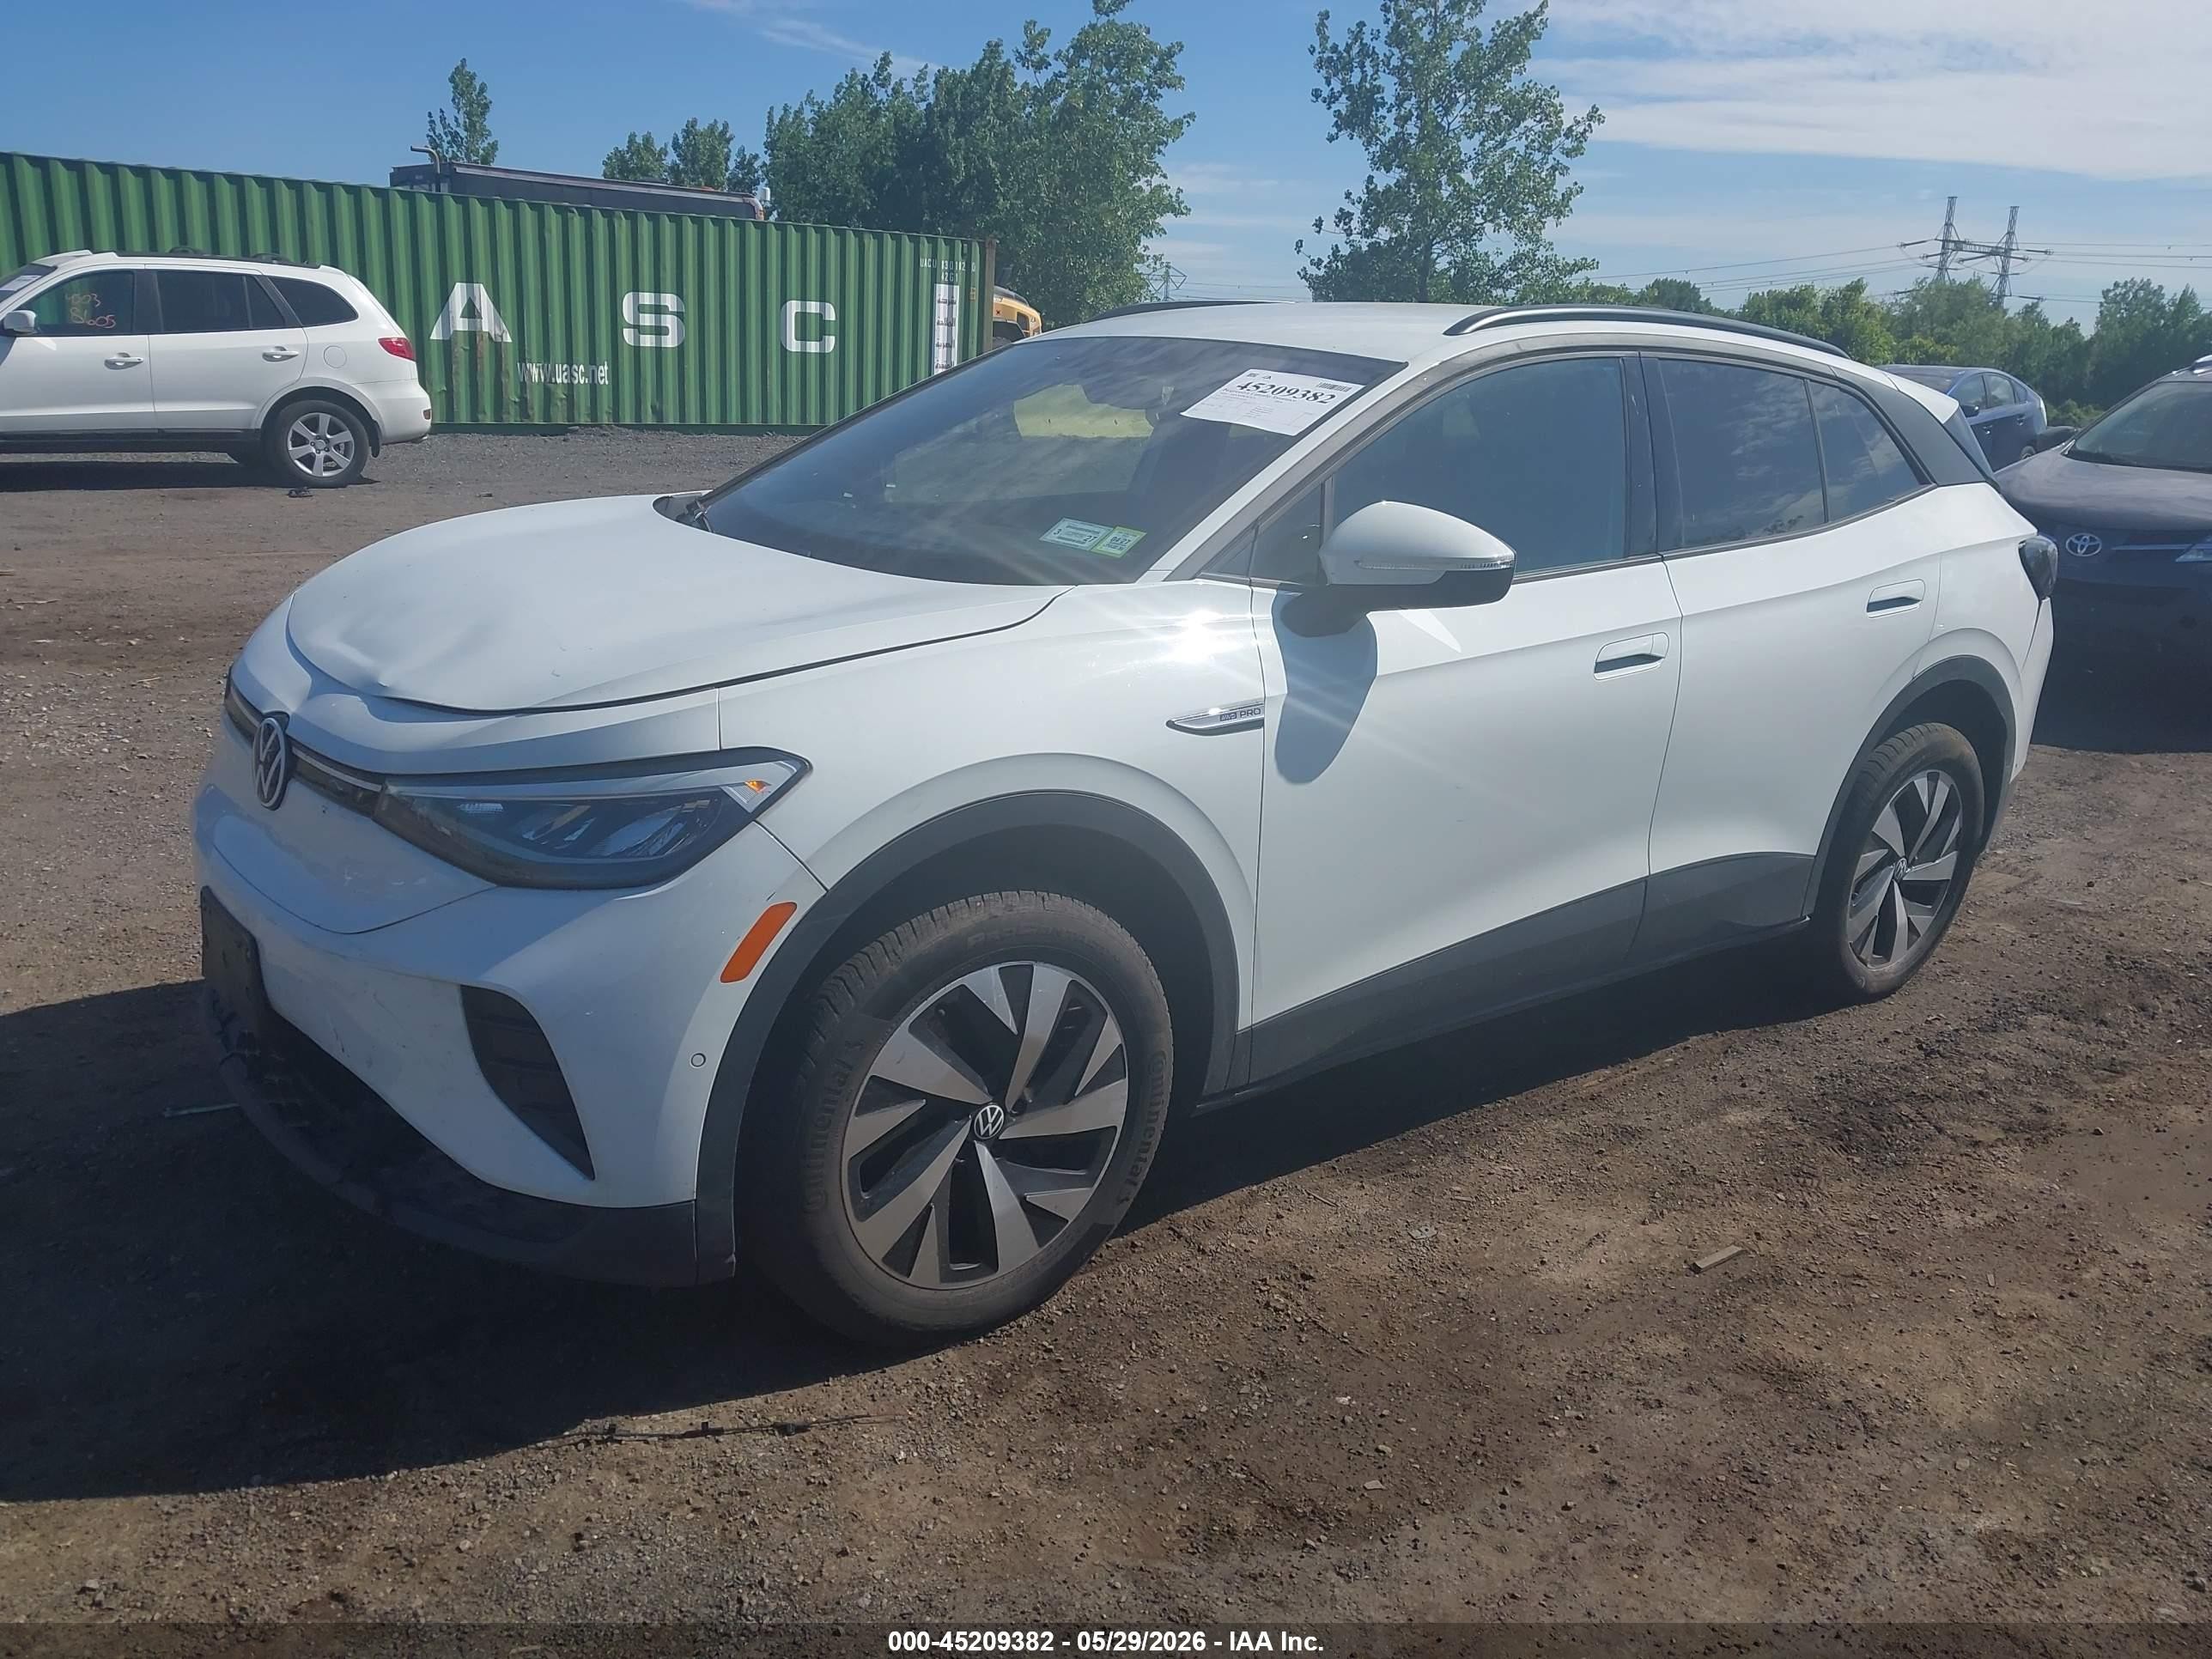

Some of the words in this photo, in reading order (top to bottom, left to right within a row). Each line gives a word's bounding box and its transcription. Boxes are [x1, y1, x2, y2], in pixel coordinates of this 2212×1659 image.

[941, 271, 958, 283] 42G1
[516, 361, 610, 385] www.uasc.net
[1237, 381, 1337, 404] 45209382
[1239, 708, 1261, 719] PRO
